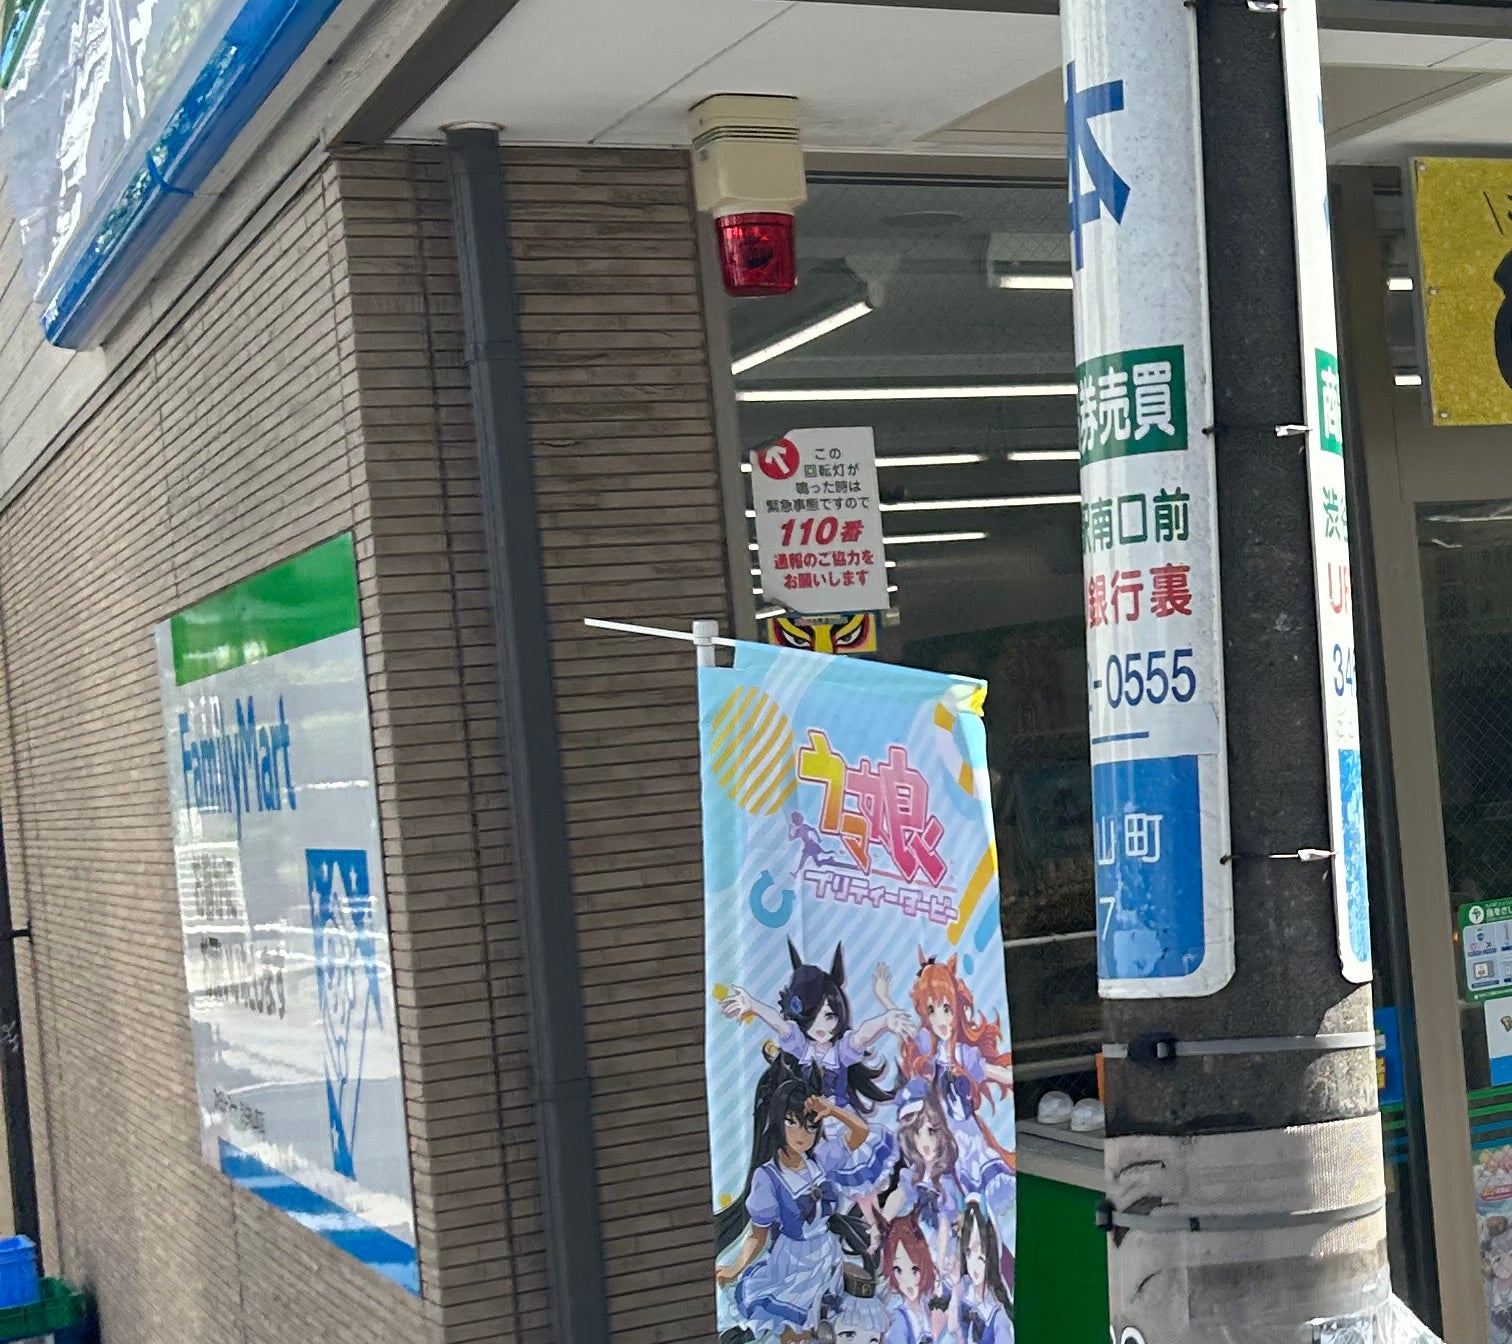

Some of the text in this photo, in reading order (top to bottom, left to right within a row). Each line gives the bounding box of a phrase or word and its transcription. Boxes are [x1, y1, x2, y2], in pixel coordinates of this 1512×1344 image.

[814, 447, 842, 461] この
[803, 463, 860, 478] 回転灯が
[779, 515, 865, 547] 110番
[1081, 486, 1191, 555] 南口前
[773, 549, 875, 570] 通報のご協力を
[783, 569, 870, 590] お願いします
[1092, 647, 1197, 709] -0555
[178, 695, 299, 838] FamilyMart
